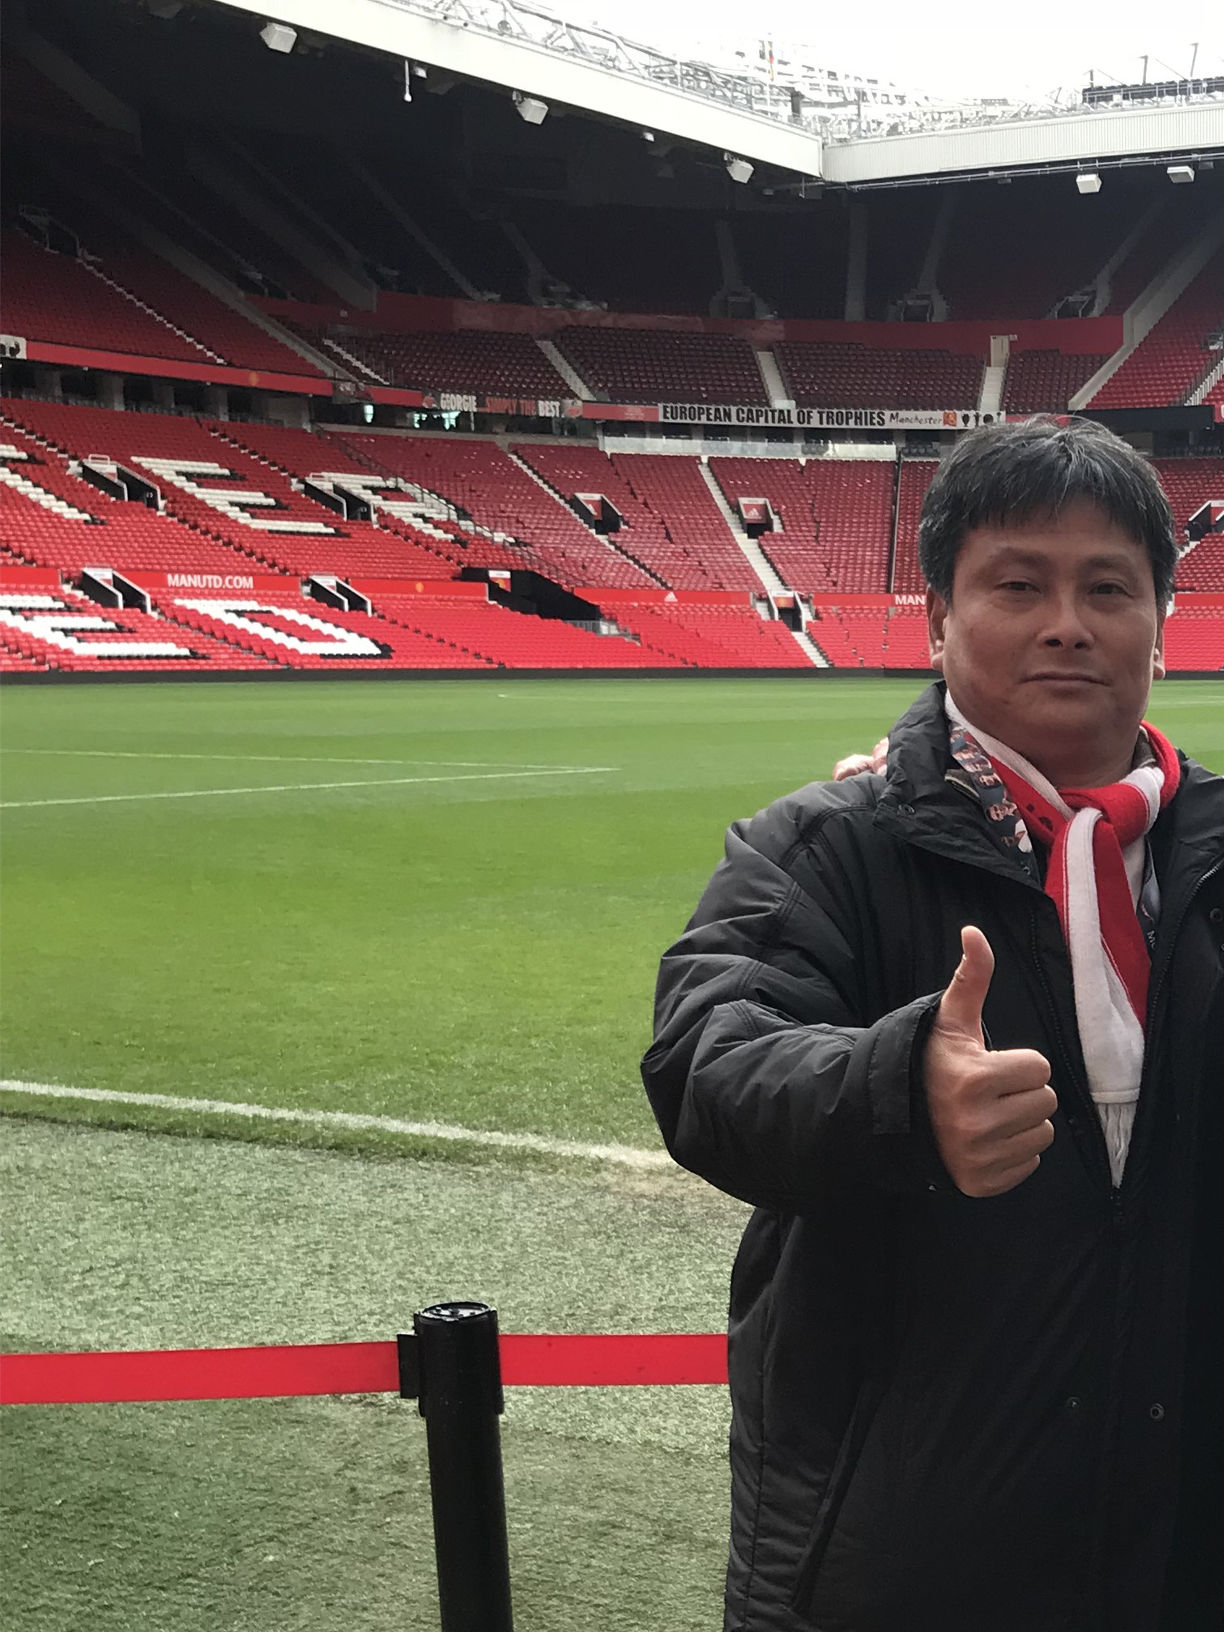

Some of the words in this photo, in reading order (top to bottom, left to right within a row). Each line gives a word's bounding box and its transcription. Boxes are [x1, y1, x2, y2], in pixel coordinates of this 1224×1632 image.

[440, 392, 477, 412] GEORGIE
[538, 400, 561, 418] BEST
[662, 405, 732, 423] EUROPEAN
[736, 408, 794, 425] CAPITAL
[796, 409, 814, 425] OF
[817, 410, 886, 427] TROPHIES
[889, 412, 942, 425] Manchester
[167, 573, 253, 589] MANUTD.COM
